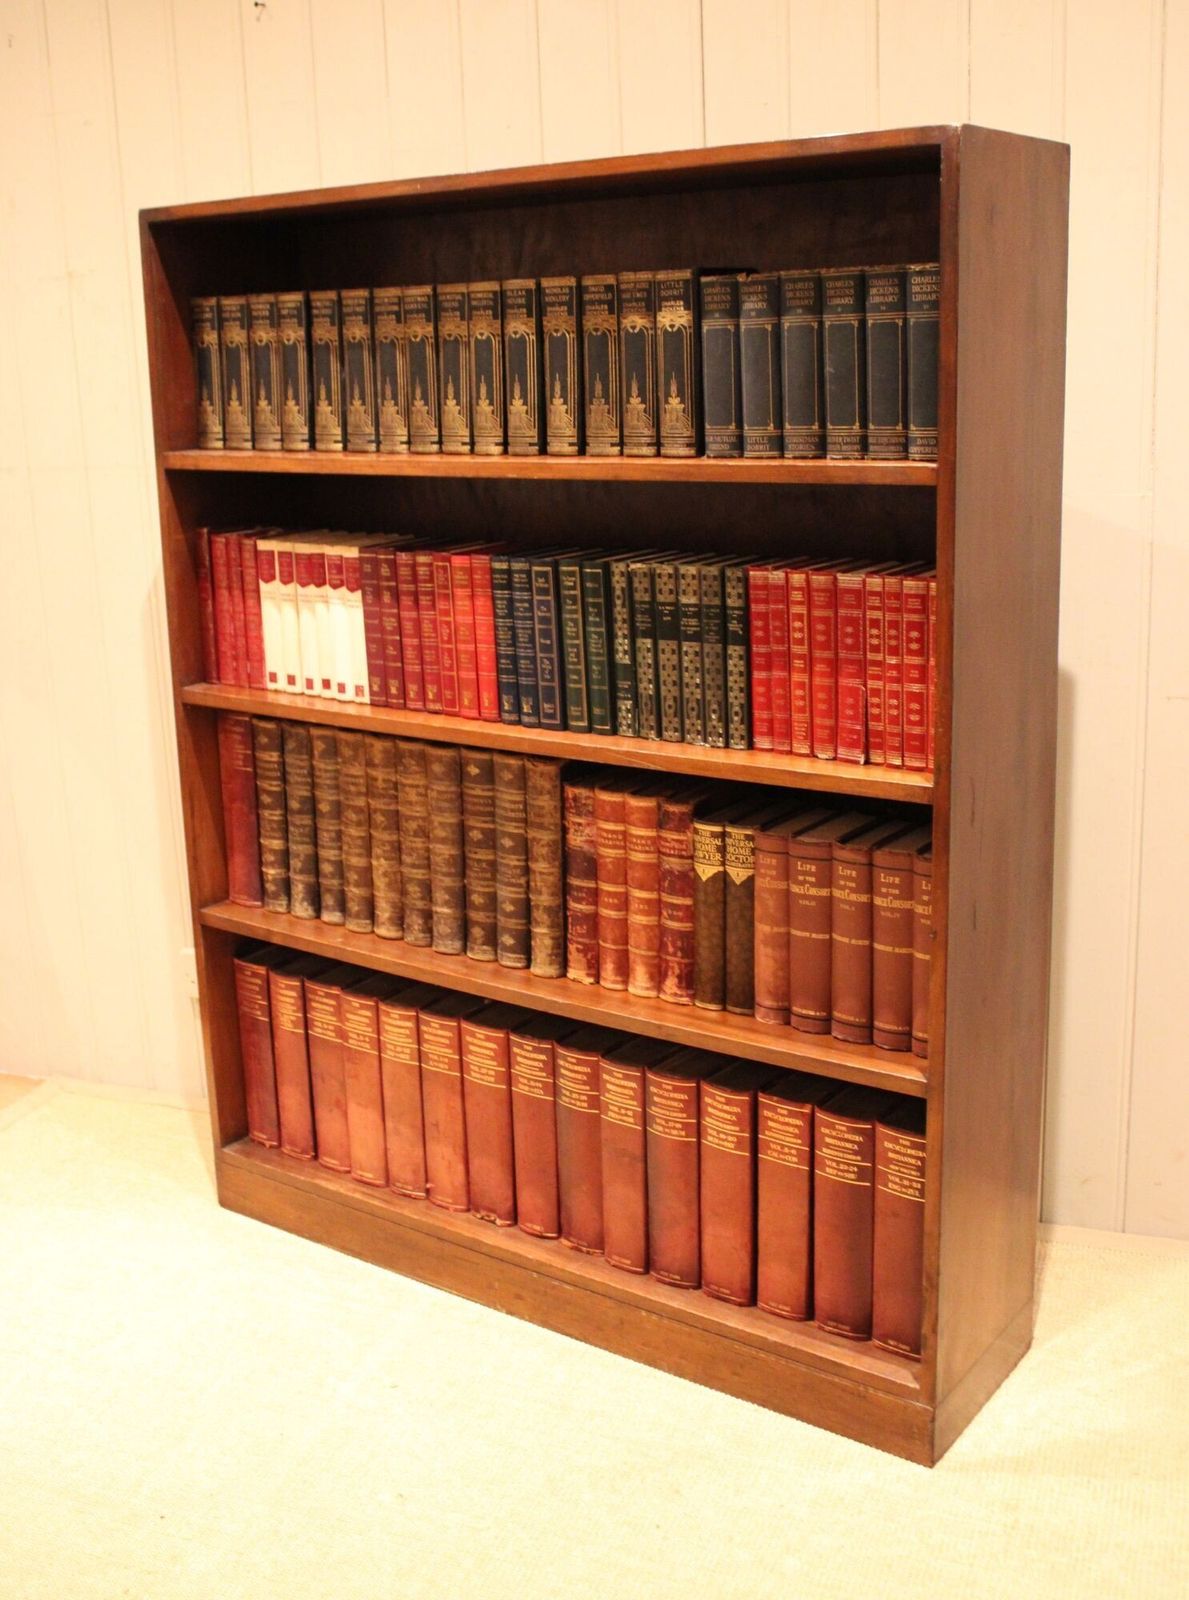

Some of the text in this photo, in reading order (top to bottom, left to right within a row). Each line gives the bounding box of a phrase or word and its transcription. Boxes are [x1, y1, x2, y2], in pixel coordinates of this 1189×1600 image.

[661, 281, 684, 289] LITTLE
[869, 278, 899, 286] CHARLES
[660, 288, 684, 297] DORRIT
[869, 286, 899, 295] DICKENS
[870, 295, 898, 303] LIBRARY
[698, 829, 711, 837] THE
[725, 837, 754, 848] NIVERSA
[726, 846, 752, 856] HOME
[760, 854, 777, 865] LIFE
[797, 861, 816, 872] LIFE
[840, 866, 857, 877] LIFE
[880, 873, 900, 884] LIFE
[922, 881, 931, 890] LI
